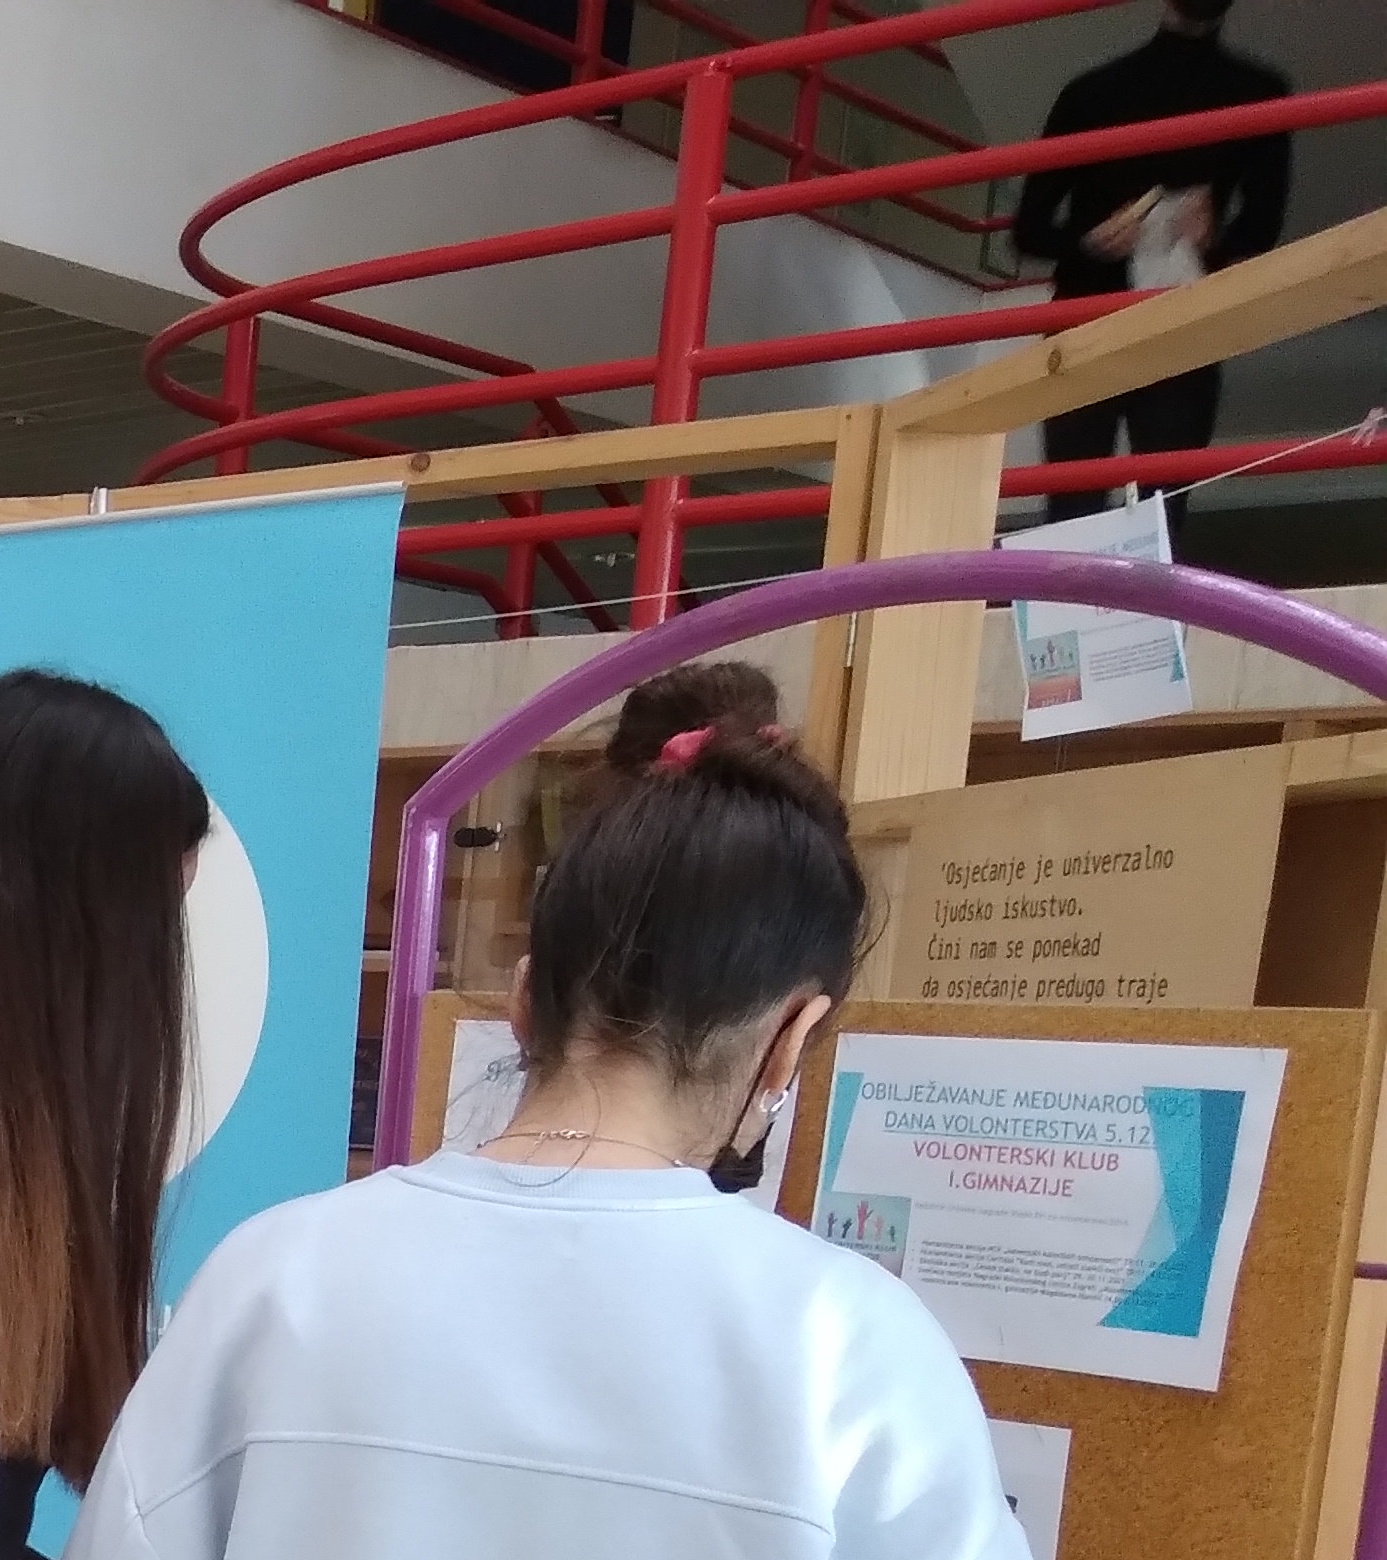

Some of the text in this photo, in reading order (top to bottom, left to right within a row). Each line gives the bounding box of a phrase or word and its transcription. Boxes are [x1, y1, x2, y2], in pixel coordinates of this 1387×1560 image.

[1034, 854, 1053, 884] je
[1062, 844, 1174, 876] univerzalno
[934, 894, 1083, 928] ljudsko iskustvo.
[970, 939, 997, 959] nam
[1006, 938, 1024, 959] se
[1031, 931, 1102, 963] ponekad
[922, 972, 1168, 1004] da osjećanje predugo traje
[861, 1080, 1006, 1110] OBILJEŽAVANJE
[884, 1110, 936, 1132] DANA
[943, 1114, 1098, 1143] VOLONTERSTVA
[913, 1140, 1119, 1173] VOLONTERSKI KLUB
